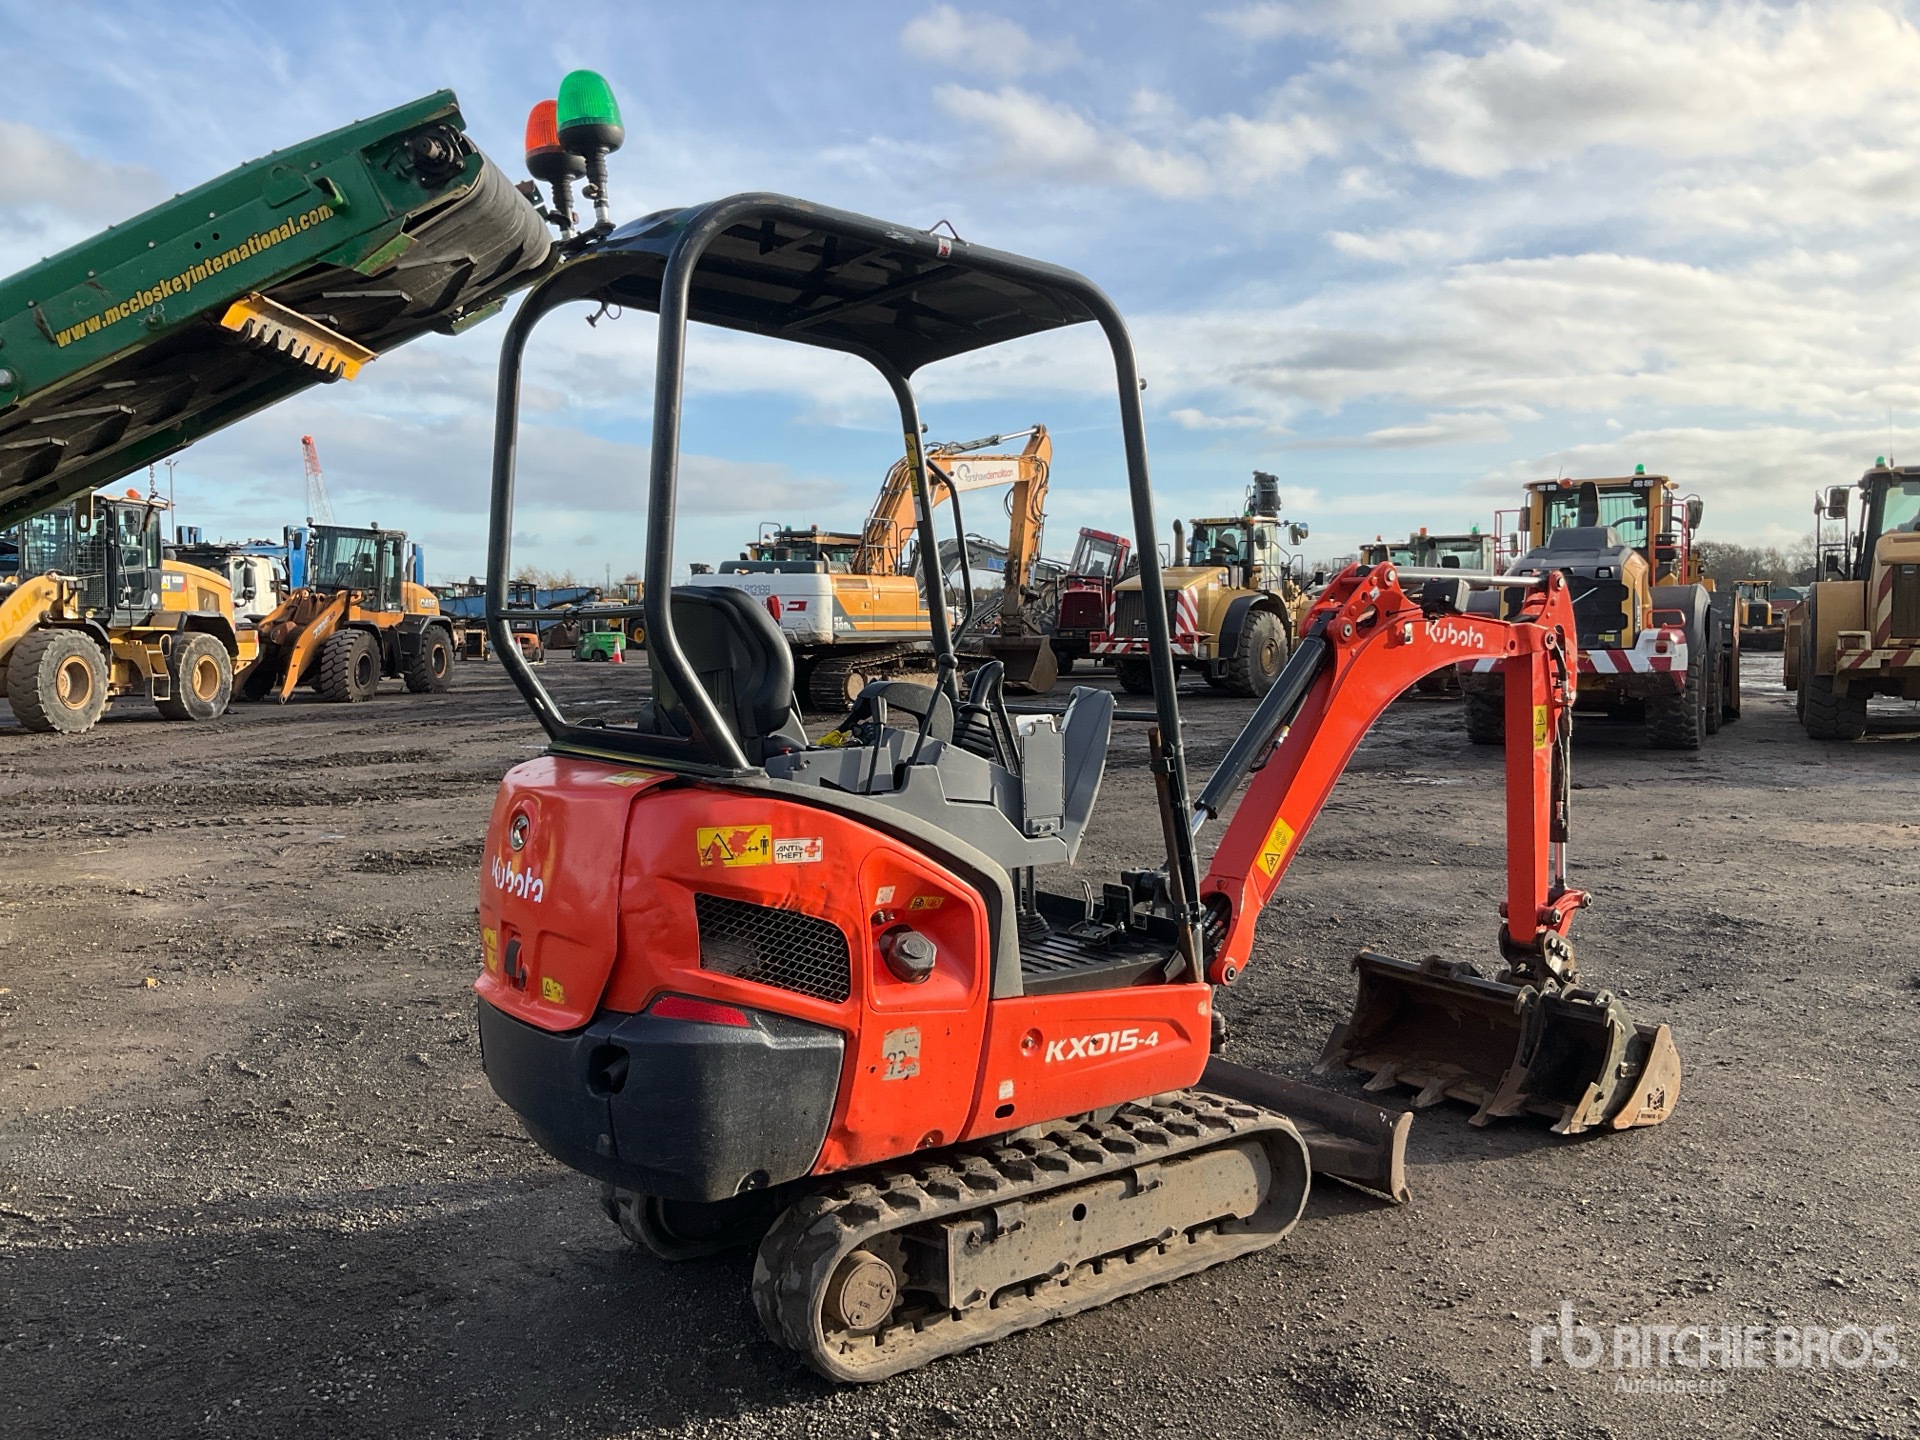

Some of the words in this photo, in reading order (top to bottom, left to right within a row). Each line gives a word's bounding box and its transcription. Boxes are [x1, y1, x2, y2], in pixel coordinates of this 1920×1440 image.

[55, 204, 334, 348] www.mccloskeyinternational.com
[420, 598, 436, 609] CASE
[1425, 619, 1484, 649] Kubota
[776, 851, 803, 860] THEFT
[491, 854, 544, 904] Kubota
[1045, 1028, 1159, 1063] KX015-4
